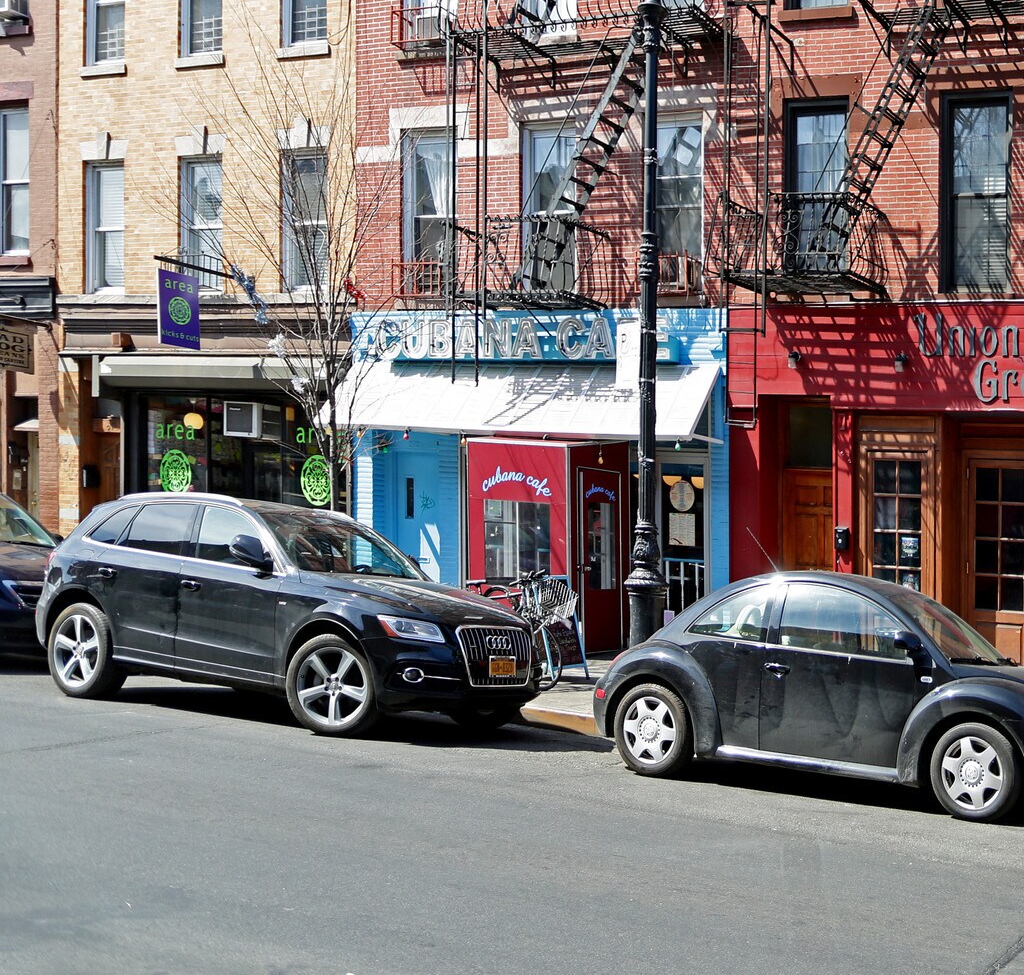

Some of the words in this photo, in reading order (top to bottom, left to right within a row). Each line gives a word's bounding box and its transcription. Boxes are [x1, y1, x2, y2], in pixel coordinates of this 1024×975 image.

[165, 278, 194, 294] area
[0, 333, 25, 344] AD
[161, 328, 180, 339] kicks
[186, 333, 200, 343] cuts
[376, 318, 541, 360] CUBANA
[556, 317, 671, 360] CAE
[913, 312, 1020, 357] Union
[0, 341, 26, 353] OG
[155, 422, 196, 441] area
[482, 466, 526, 492] cubana
[526, 474, 552, 497] cafe
[585, 484, 604, 499] cubana
[604, 488, 617, 502] cafe
